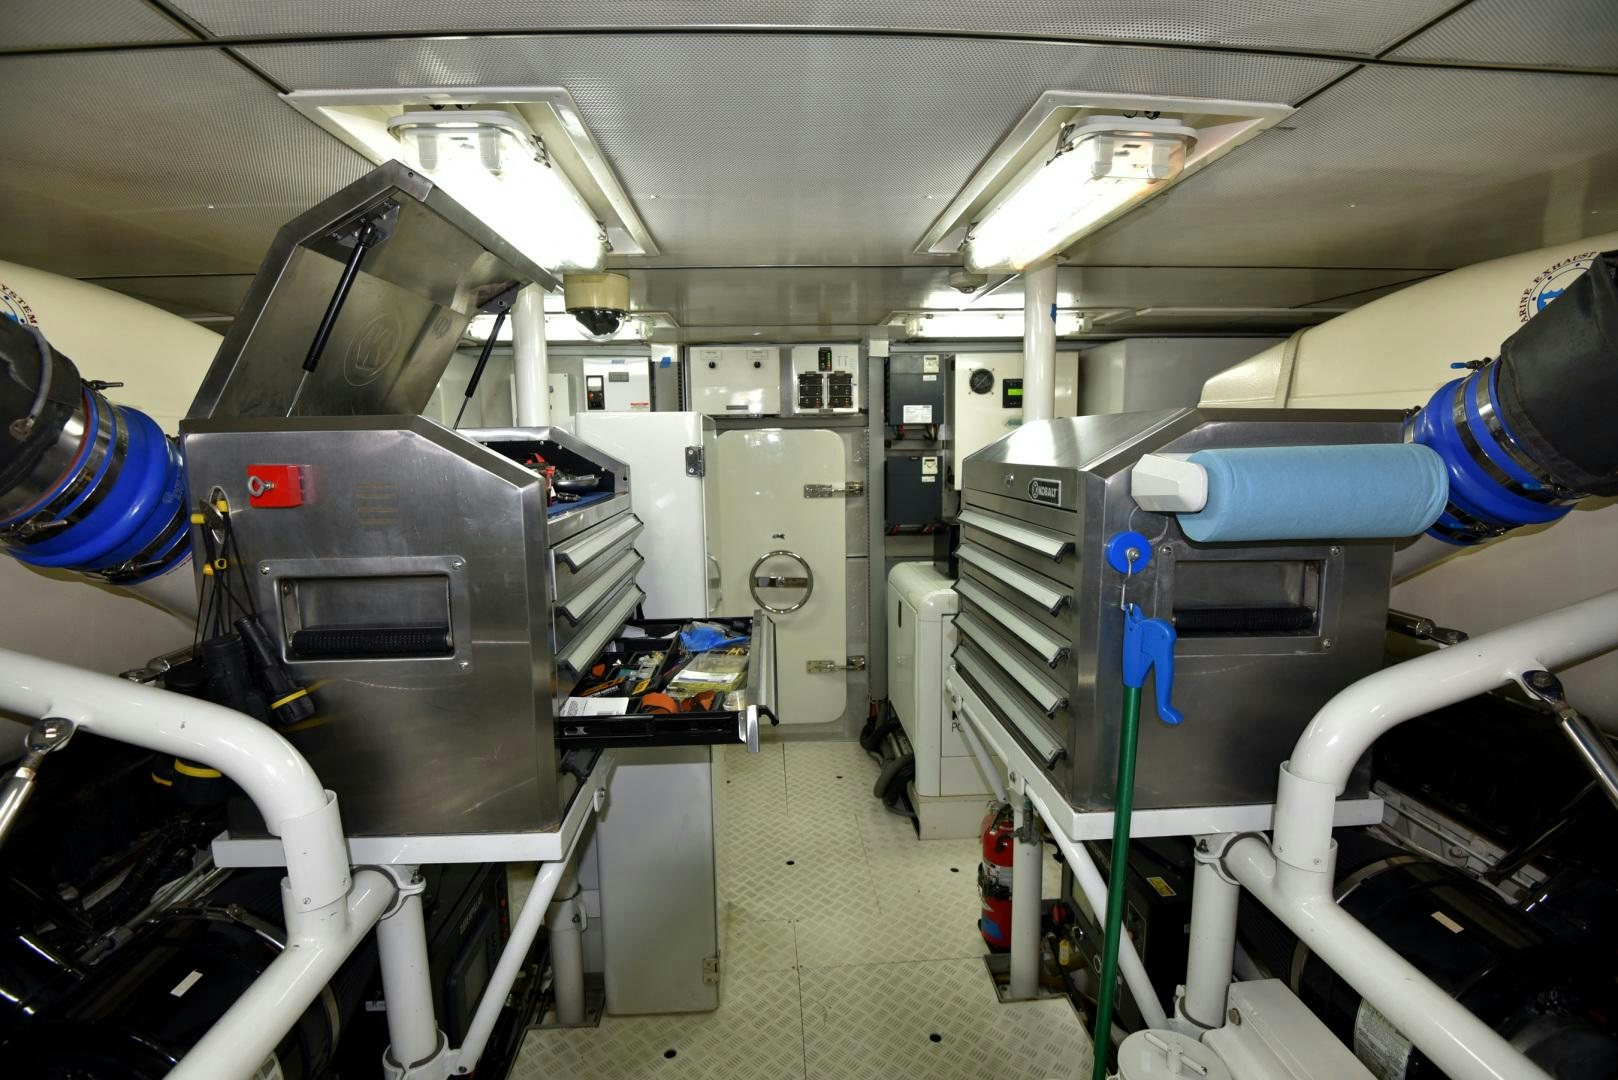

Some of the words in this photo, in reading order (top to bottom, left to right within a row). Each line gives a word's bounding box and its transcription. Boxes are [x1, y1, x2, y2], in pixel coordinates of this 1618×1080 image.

[1, 284, 38, 328] YSTEM
[1518, 287, 1533, 323] ARINE
[1532, 251, 1597, 284] EXHAUST
[1038, 485, 1058, 498] KOBALT
